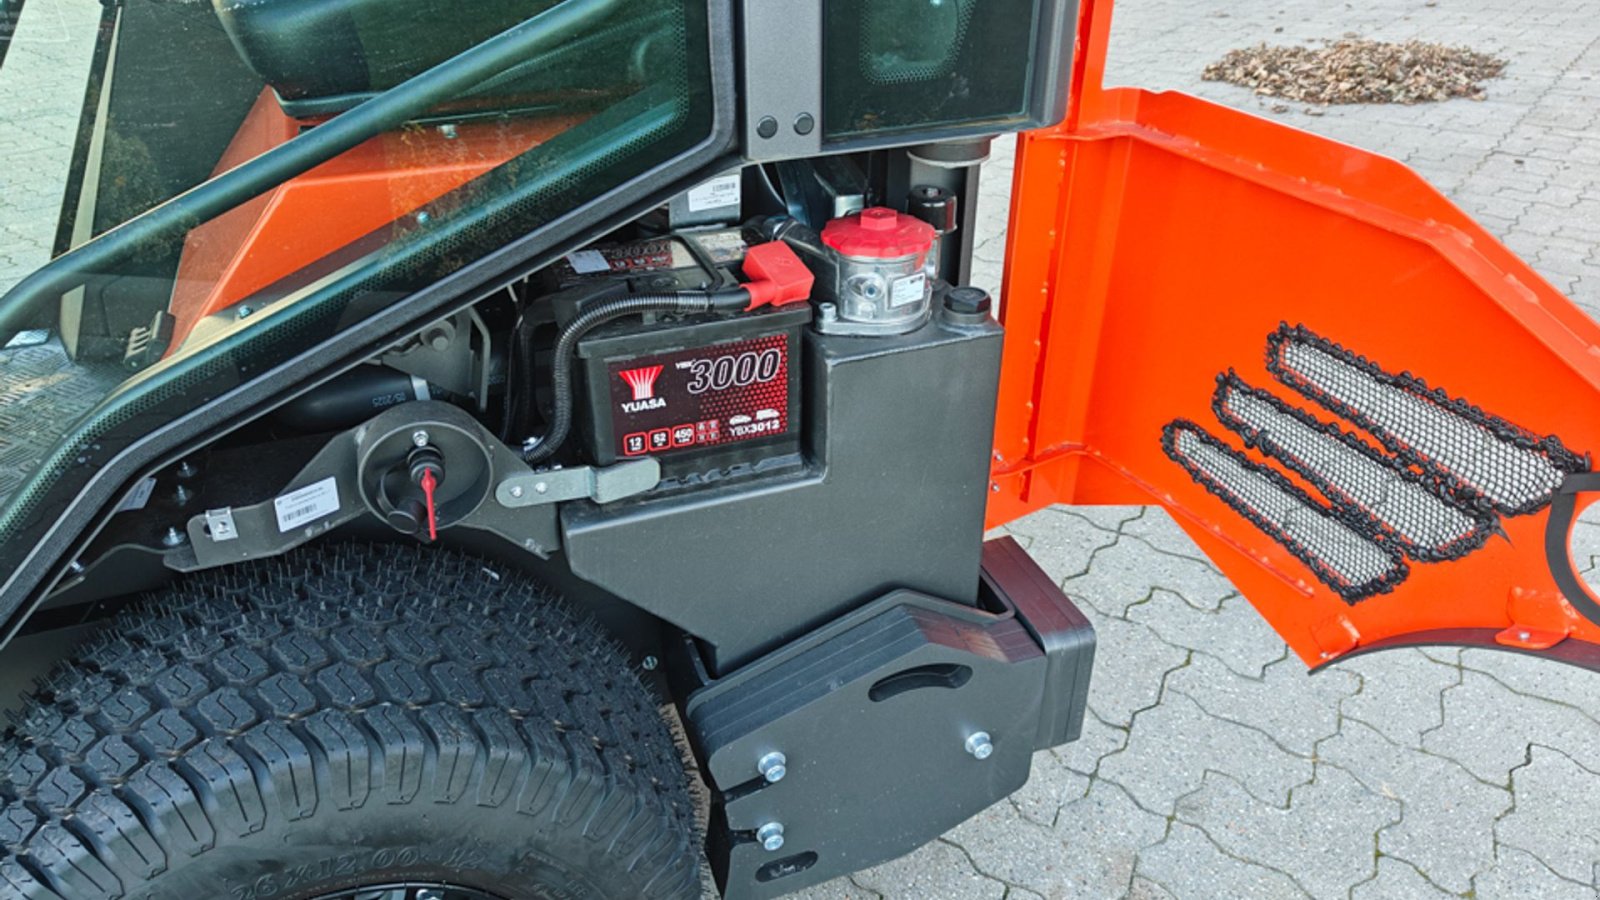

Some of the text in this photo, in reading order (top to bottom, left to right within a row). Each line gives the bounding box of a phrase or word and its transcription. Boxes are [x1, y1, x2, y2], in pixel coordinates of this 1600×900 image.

[687, 348, 780, 394] 3000
[621, 398, 666, 412] YUASA
[730, 420, 780, 436] YBX3012
[628, 436, 642, 448] 12
[653, 432, 667, 443] 52
